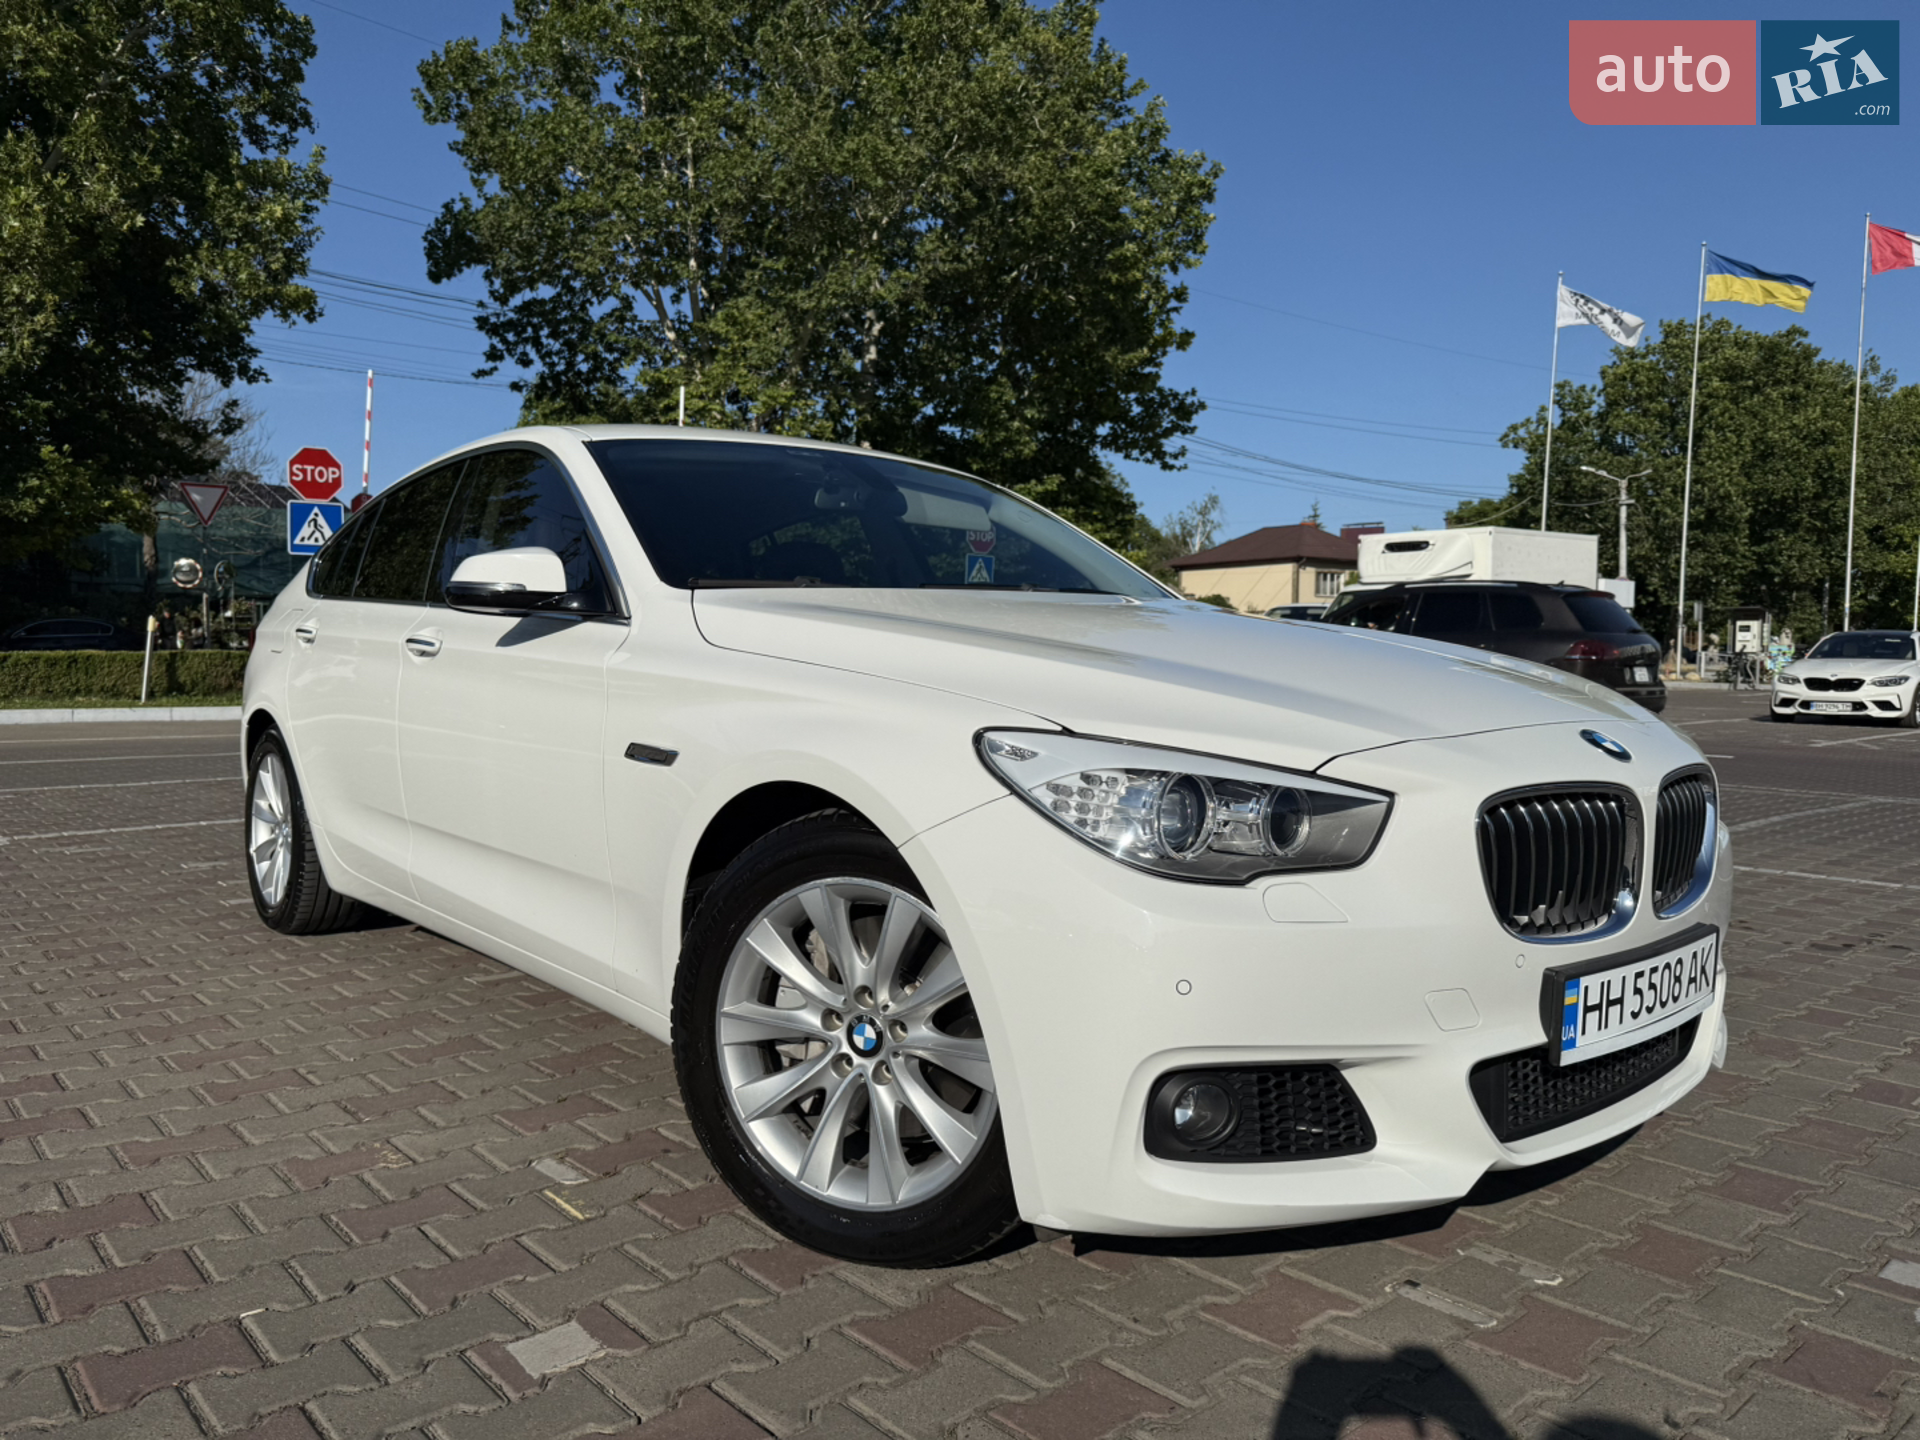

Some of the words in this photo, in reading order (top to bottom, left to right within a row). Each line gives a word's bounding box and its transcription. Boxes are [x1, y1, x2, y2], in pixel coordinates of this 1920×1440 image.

[292, 464, 340, 483] STOP
[1581, 975, 1626, 1036] HH
[1630, 957, 1683, 1020] 5508
[1685, 943, 1713, 998] AK
[1562, 1024, 1576, 1041] UA
